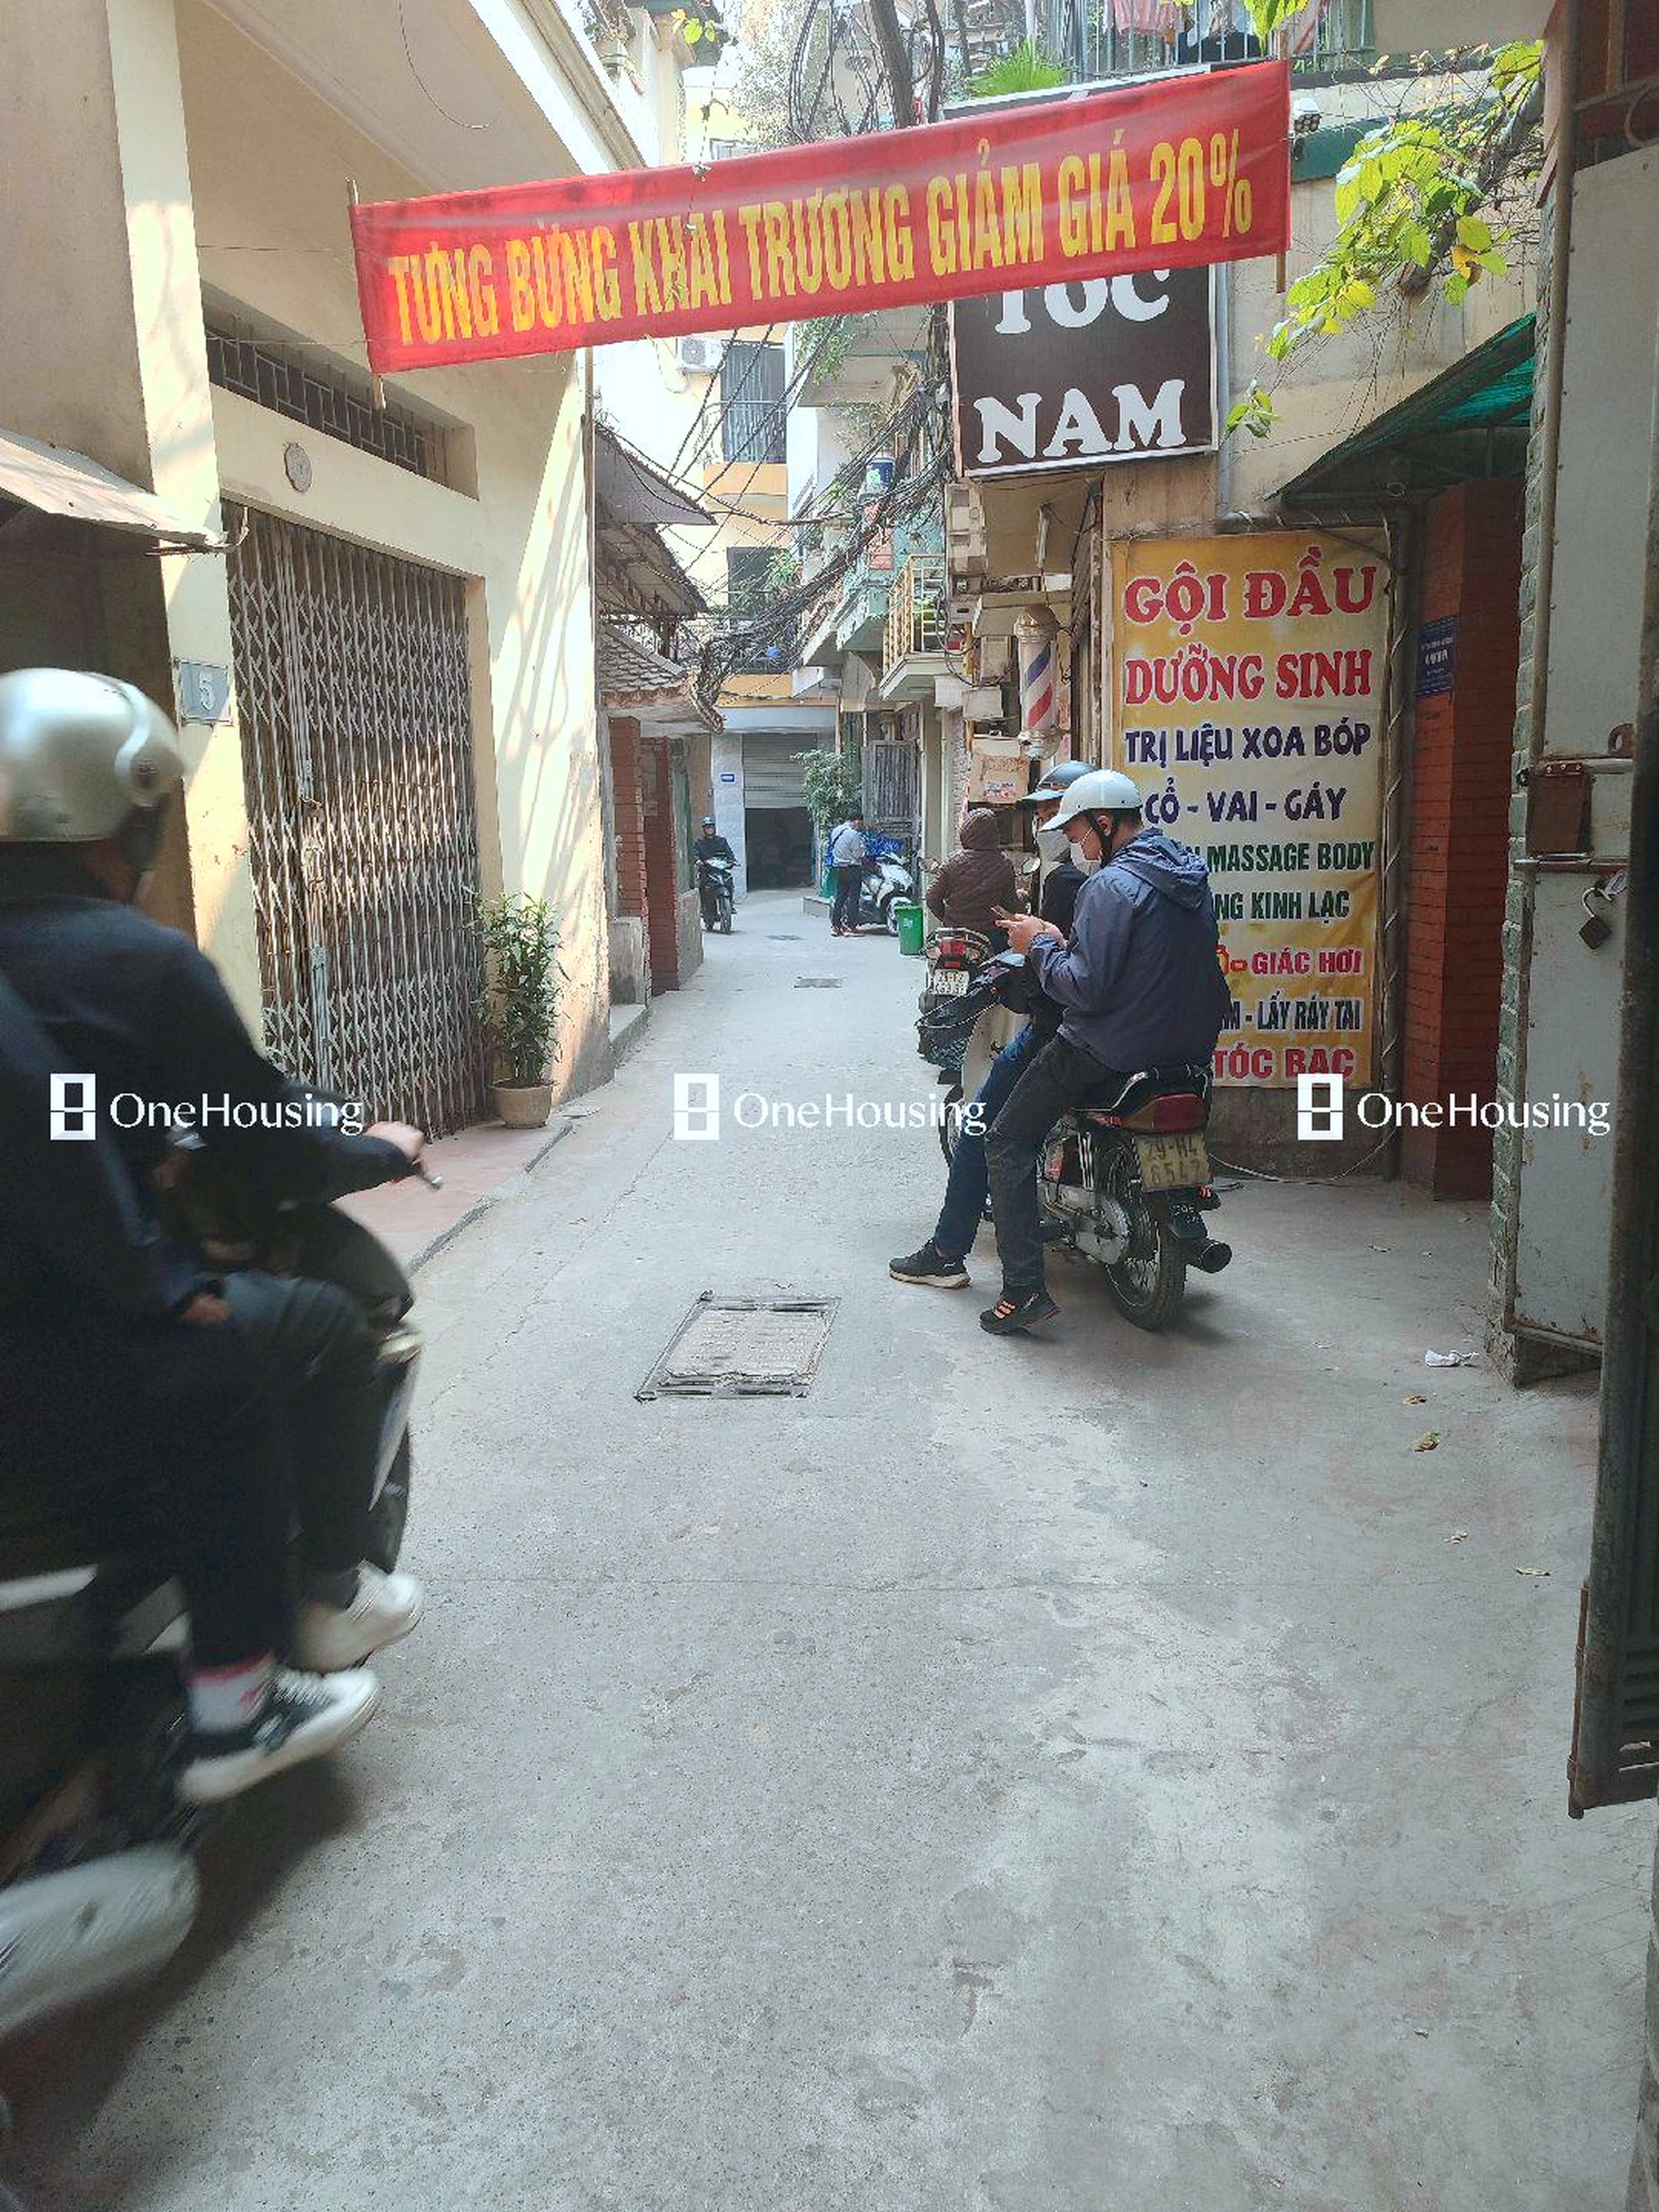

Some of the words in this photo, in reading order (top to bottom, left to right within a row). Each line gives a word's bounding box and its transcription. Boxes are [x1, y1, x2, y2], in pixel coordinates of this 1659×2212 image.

[628, 208, 732, 316] KHAI
[738, 182, 915, 301] TRƯƠNG
[926, 138, 1044, 276] GIẢM
[1057, 129, 1137, 258] GIÁ
[1149, 128, 1254, 245] 20%
[973, 378, 1186, 463] NAM
[1125, 561, 1228, 635] GỘI
[1244, 546, 1377, 618] ĐẦU
[1125, 643, 1265, 705] DƯỠNG
[1276, 649, 1372, 700] SINH
[1125, 730, 1168, 769] TRỊ
[1175, 723, 1233, 767] LIỆU
[1242, 726, 1305, 759] XOA
[1314, 718, 1371, 757] BÓP
[1145, 777, 1180, 824] CỔ
[1207, 790, 1257, 822] VAI
[1284, 783, 1347, 821] GÁY
[1207, 843, 1310, 872] MASSAGE
[1317, 841, 1375, 870] BODY
[1251, 891, 1301, 920] KINH
[1308, 891, 1350, 925] LẠC
[1252, 948, 1310, 974] GIÁC
[1319, 949, 1362, 973] HƠI
[1257, 991, 1291, 1030] LẤY
[1295, 996, 1329, 1030] RÁY
[1334, 1000, 1360, 1030] TAI
[1213, 1043, 1273, 1079] TÓC
